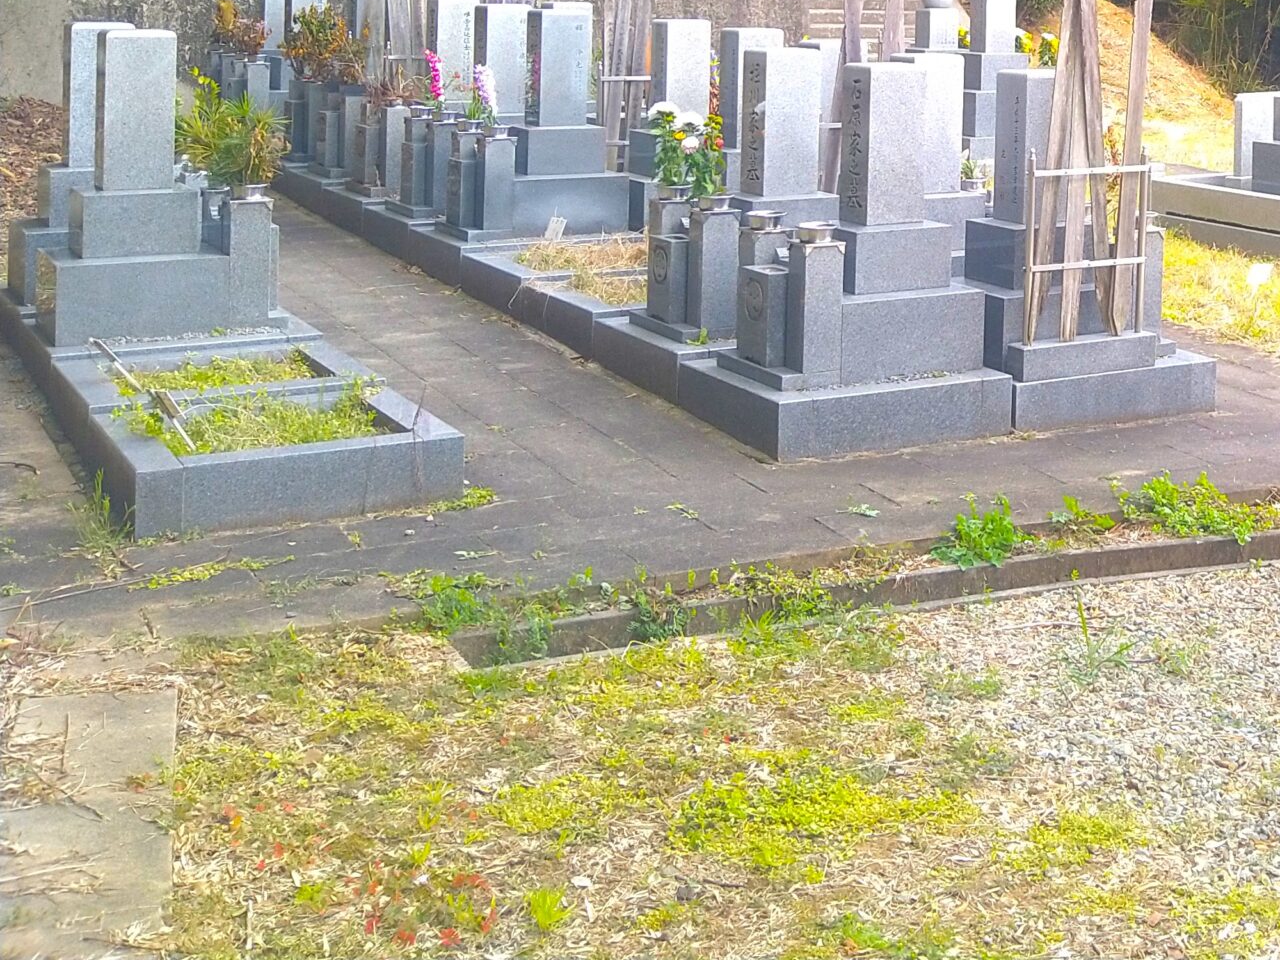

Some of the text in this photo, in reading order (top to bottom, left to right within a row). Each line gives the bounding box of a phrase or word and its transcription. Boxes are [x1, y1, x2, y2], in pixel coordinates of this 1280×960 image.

[845, 78, 863, 209] 石原家之墓
